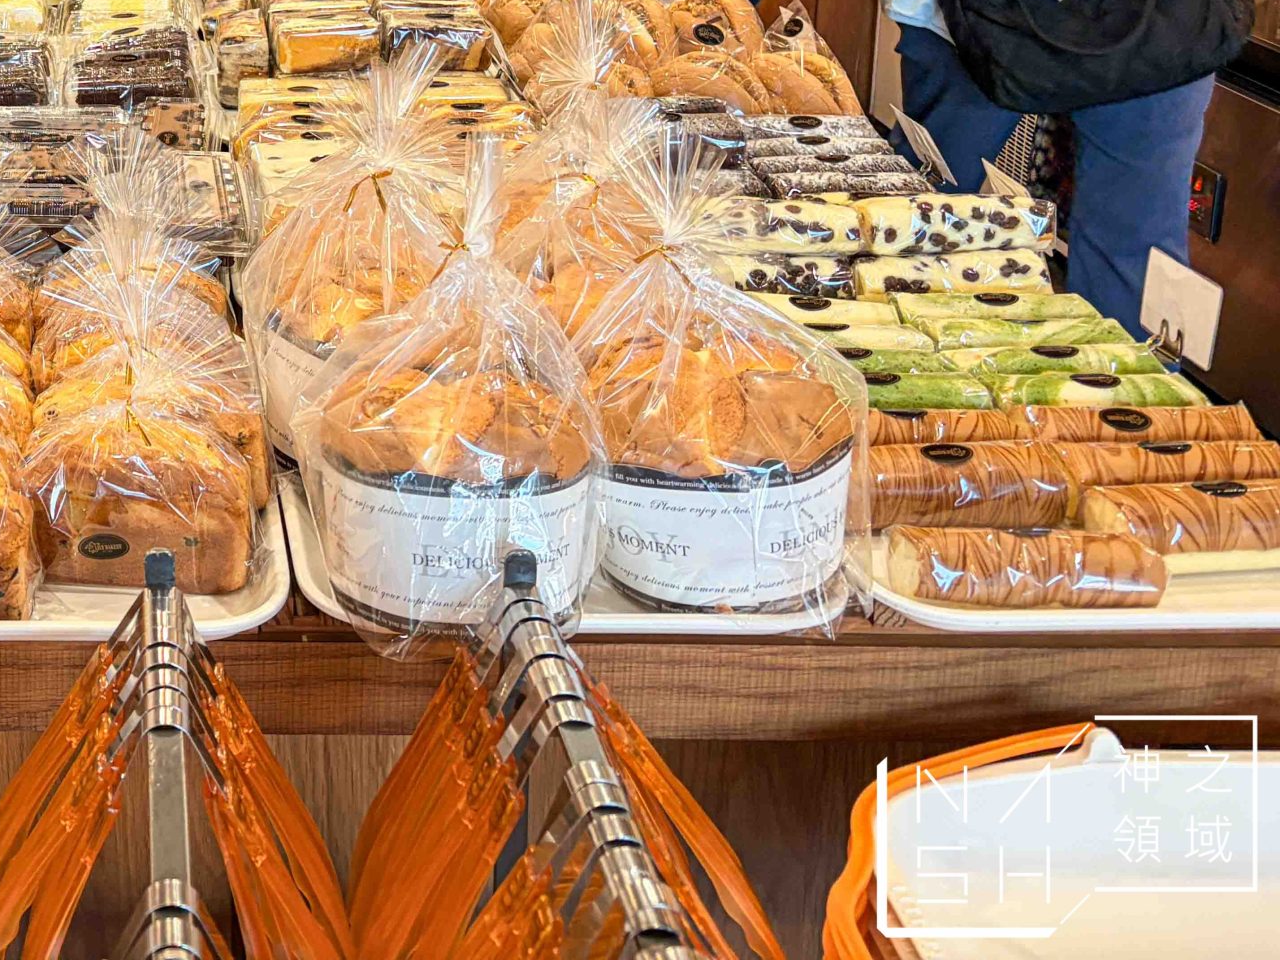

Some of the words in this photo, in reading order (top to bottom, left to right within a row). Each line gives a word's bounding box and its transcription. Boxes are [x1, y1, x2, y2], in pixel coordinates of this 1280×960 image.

[640, 477, 655, 485] with
[650, 499, 686, 513] Please
[689, 507, 717, 519] enjoy
[618, 533, 690, 557] MOMENT
[684, 585, 725, 594] moment
